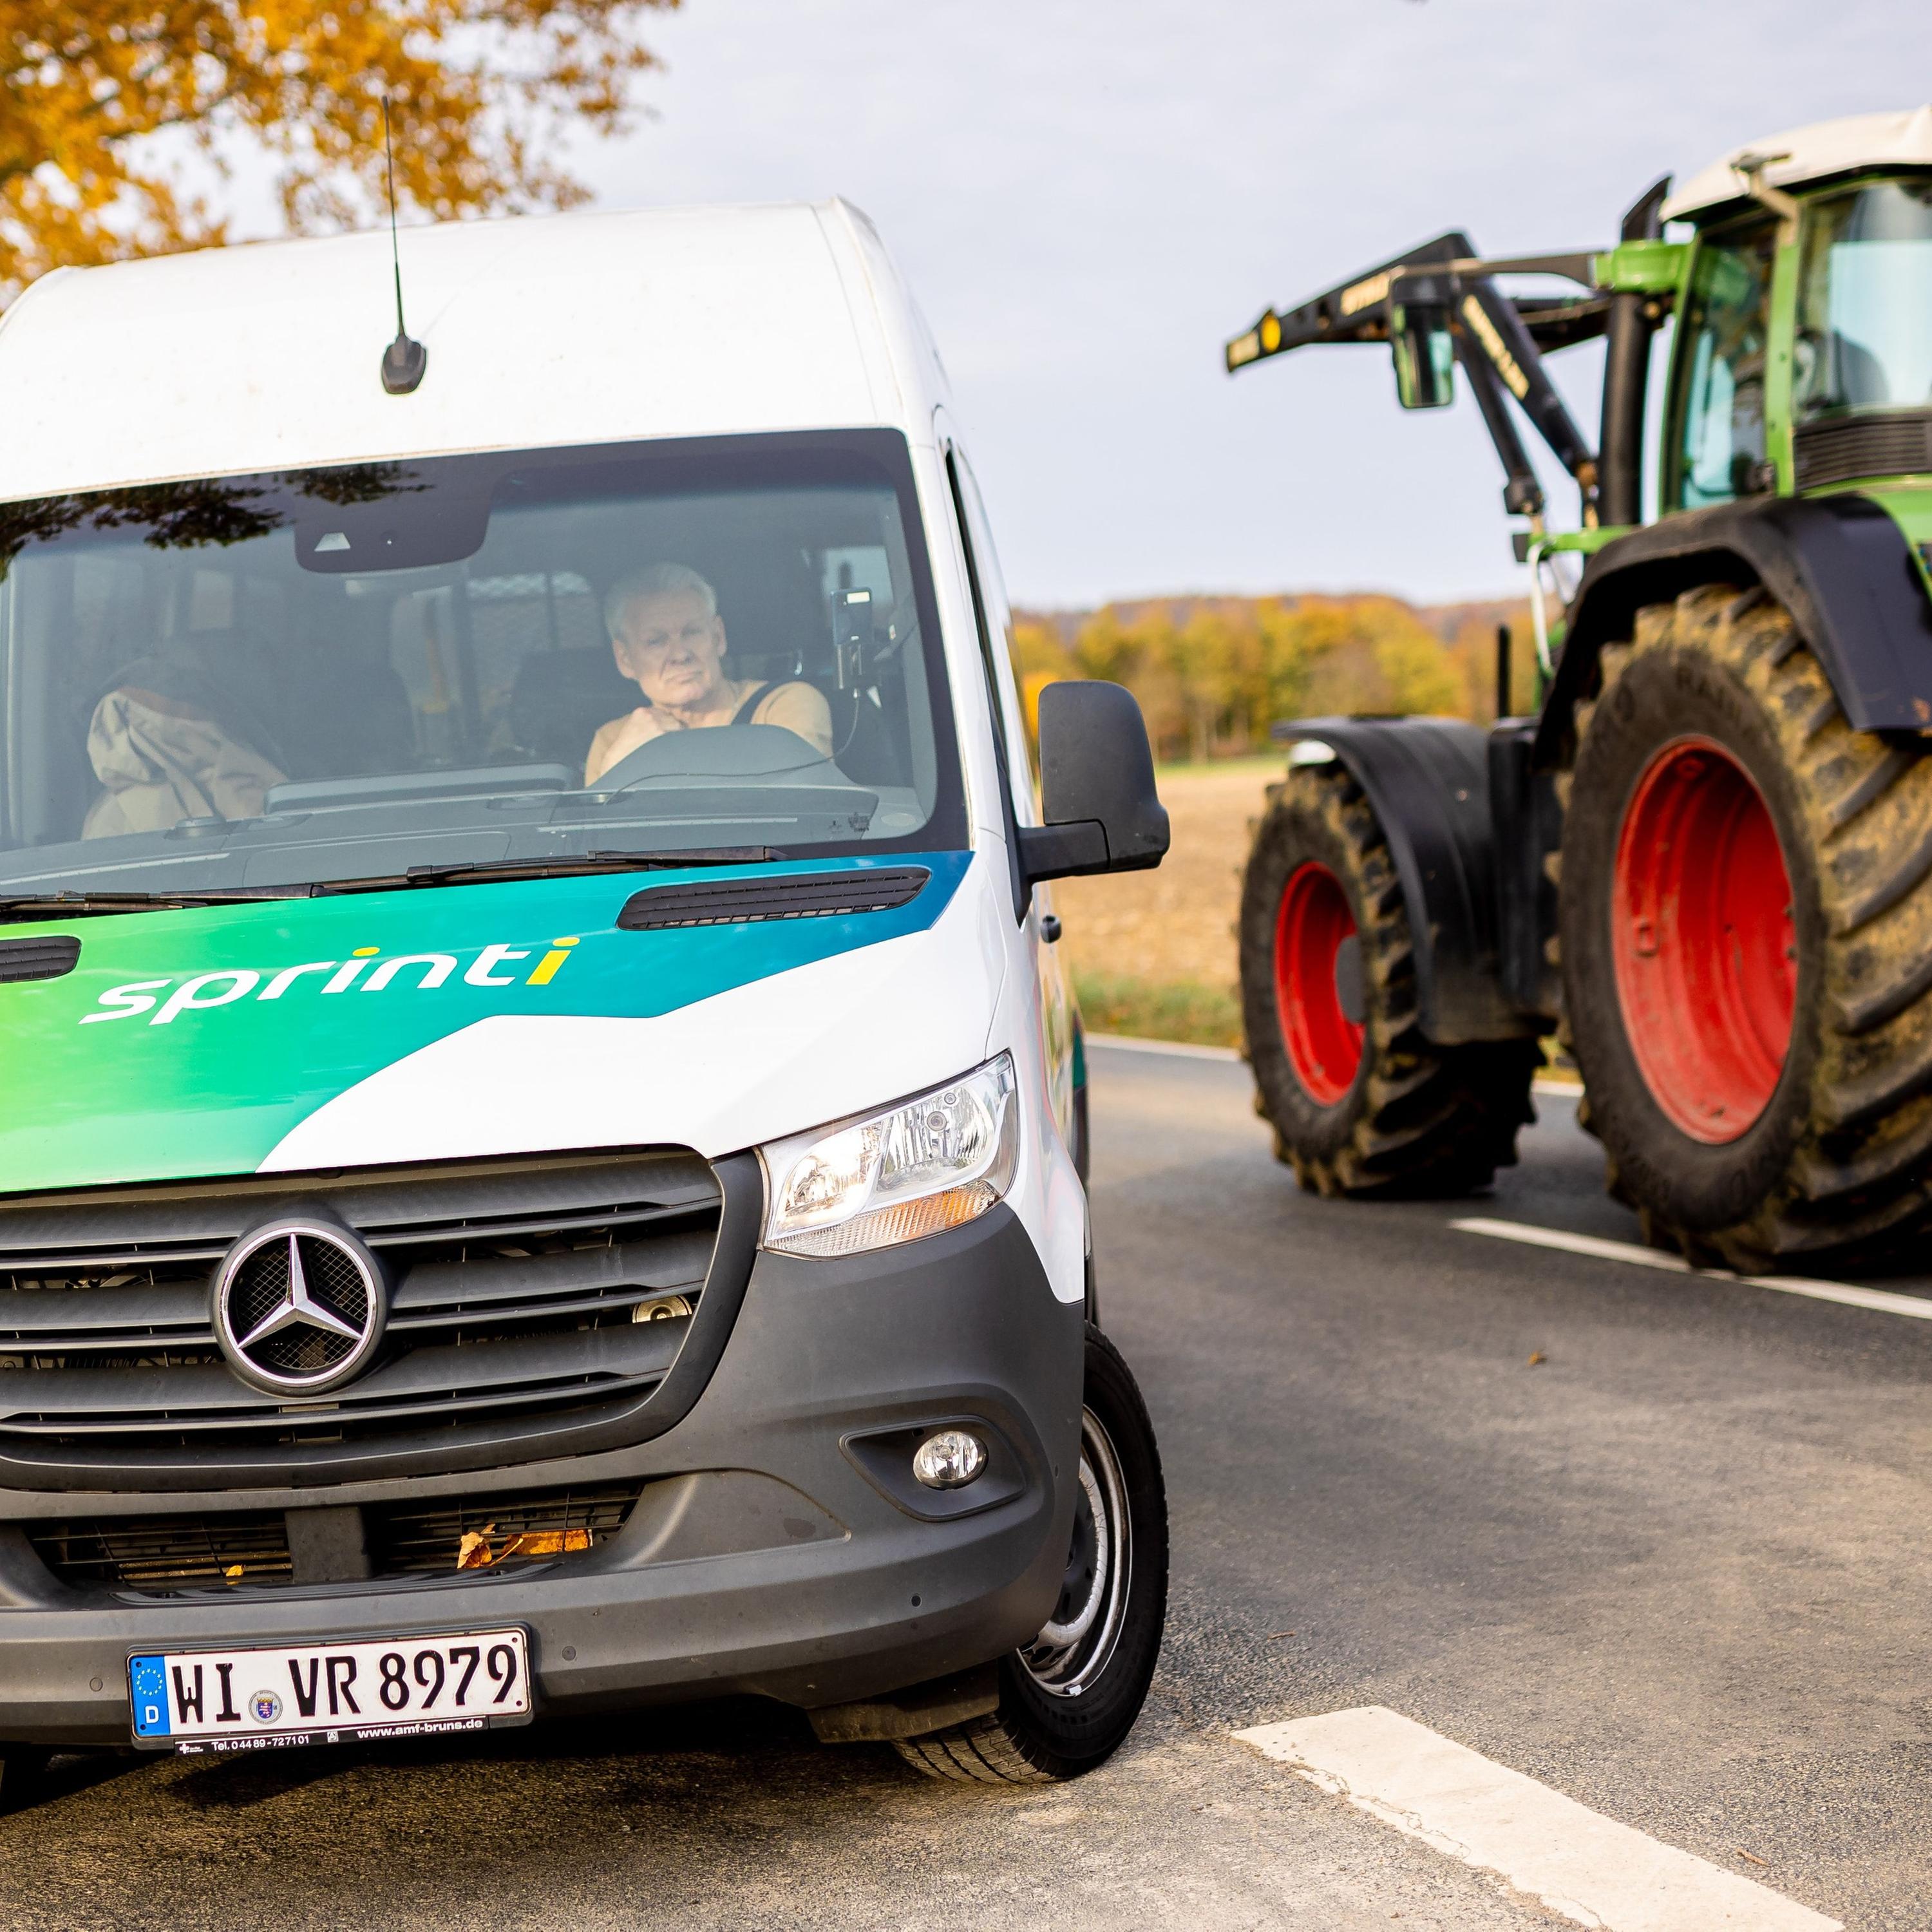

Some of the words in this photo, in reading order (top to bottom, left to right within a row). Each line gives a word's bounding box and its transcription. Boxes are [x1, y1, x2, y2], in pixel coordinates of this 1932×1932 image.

[77, 936, 580, 1027] sprinti
[171, 1662, 242, 1725] WI
[287, 1654, 361, 1718] VR
[379, 1643, 518, 1711] 8979
[145, 1705, 160, 1724] D
[357, 1719, 483, 1739] www.amf-bruns.de
[211, 1741, 230, 1751] Tel.
